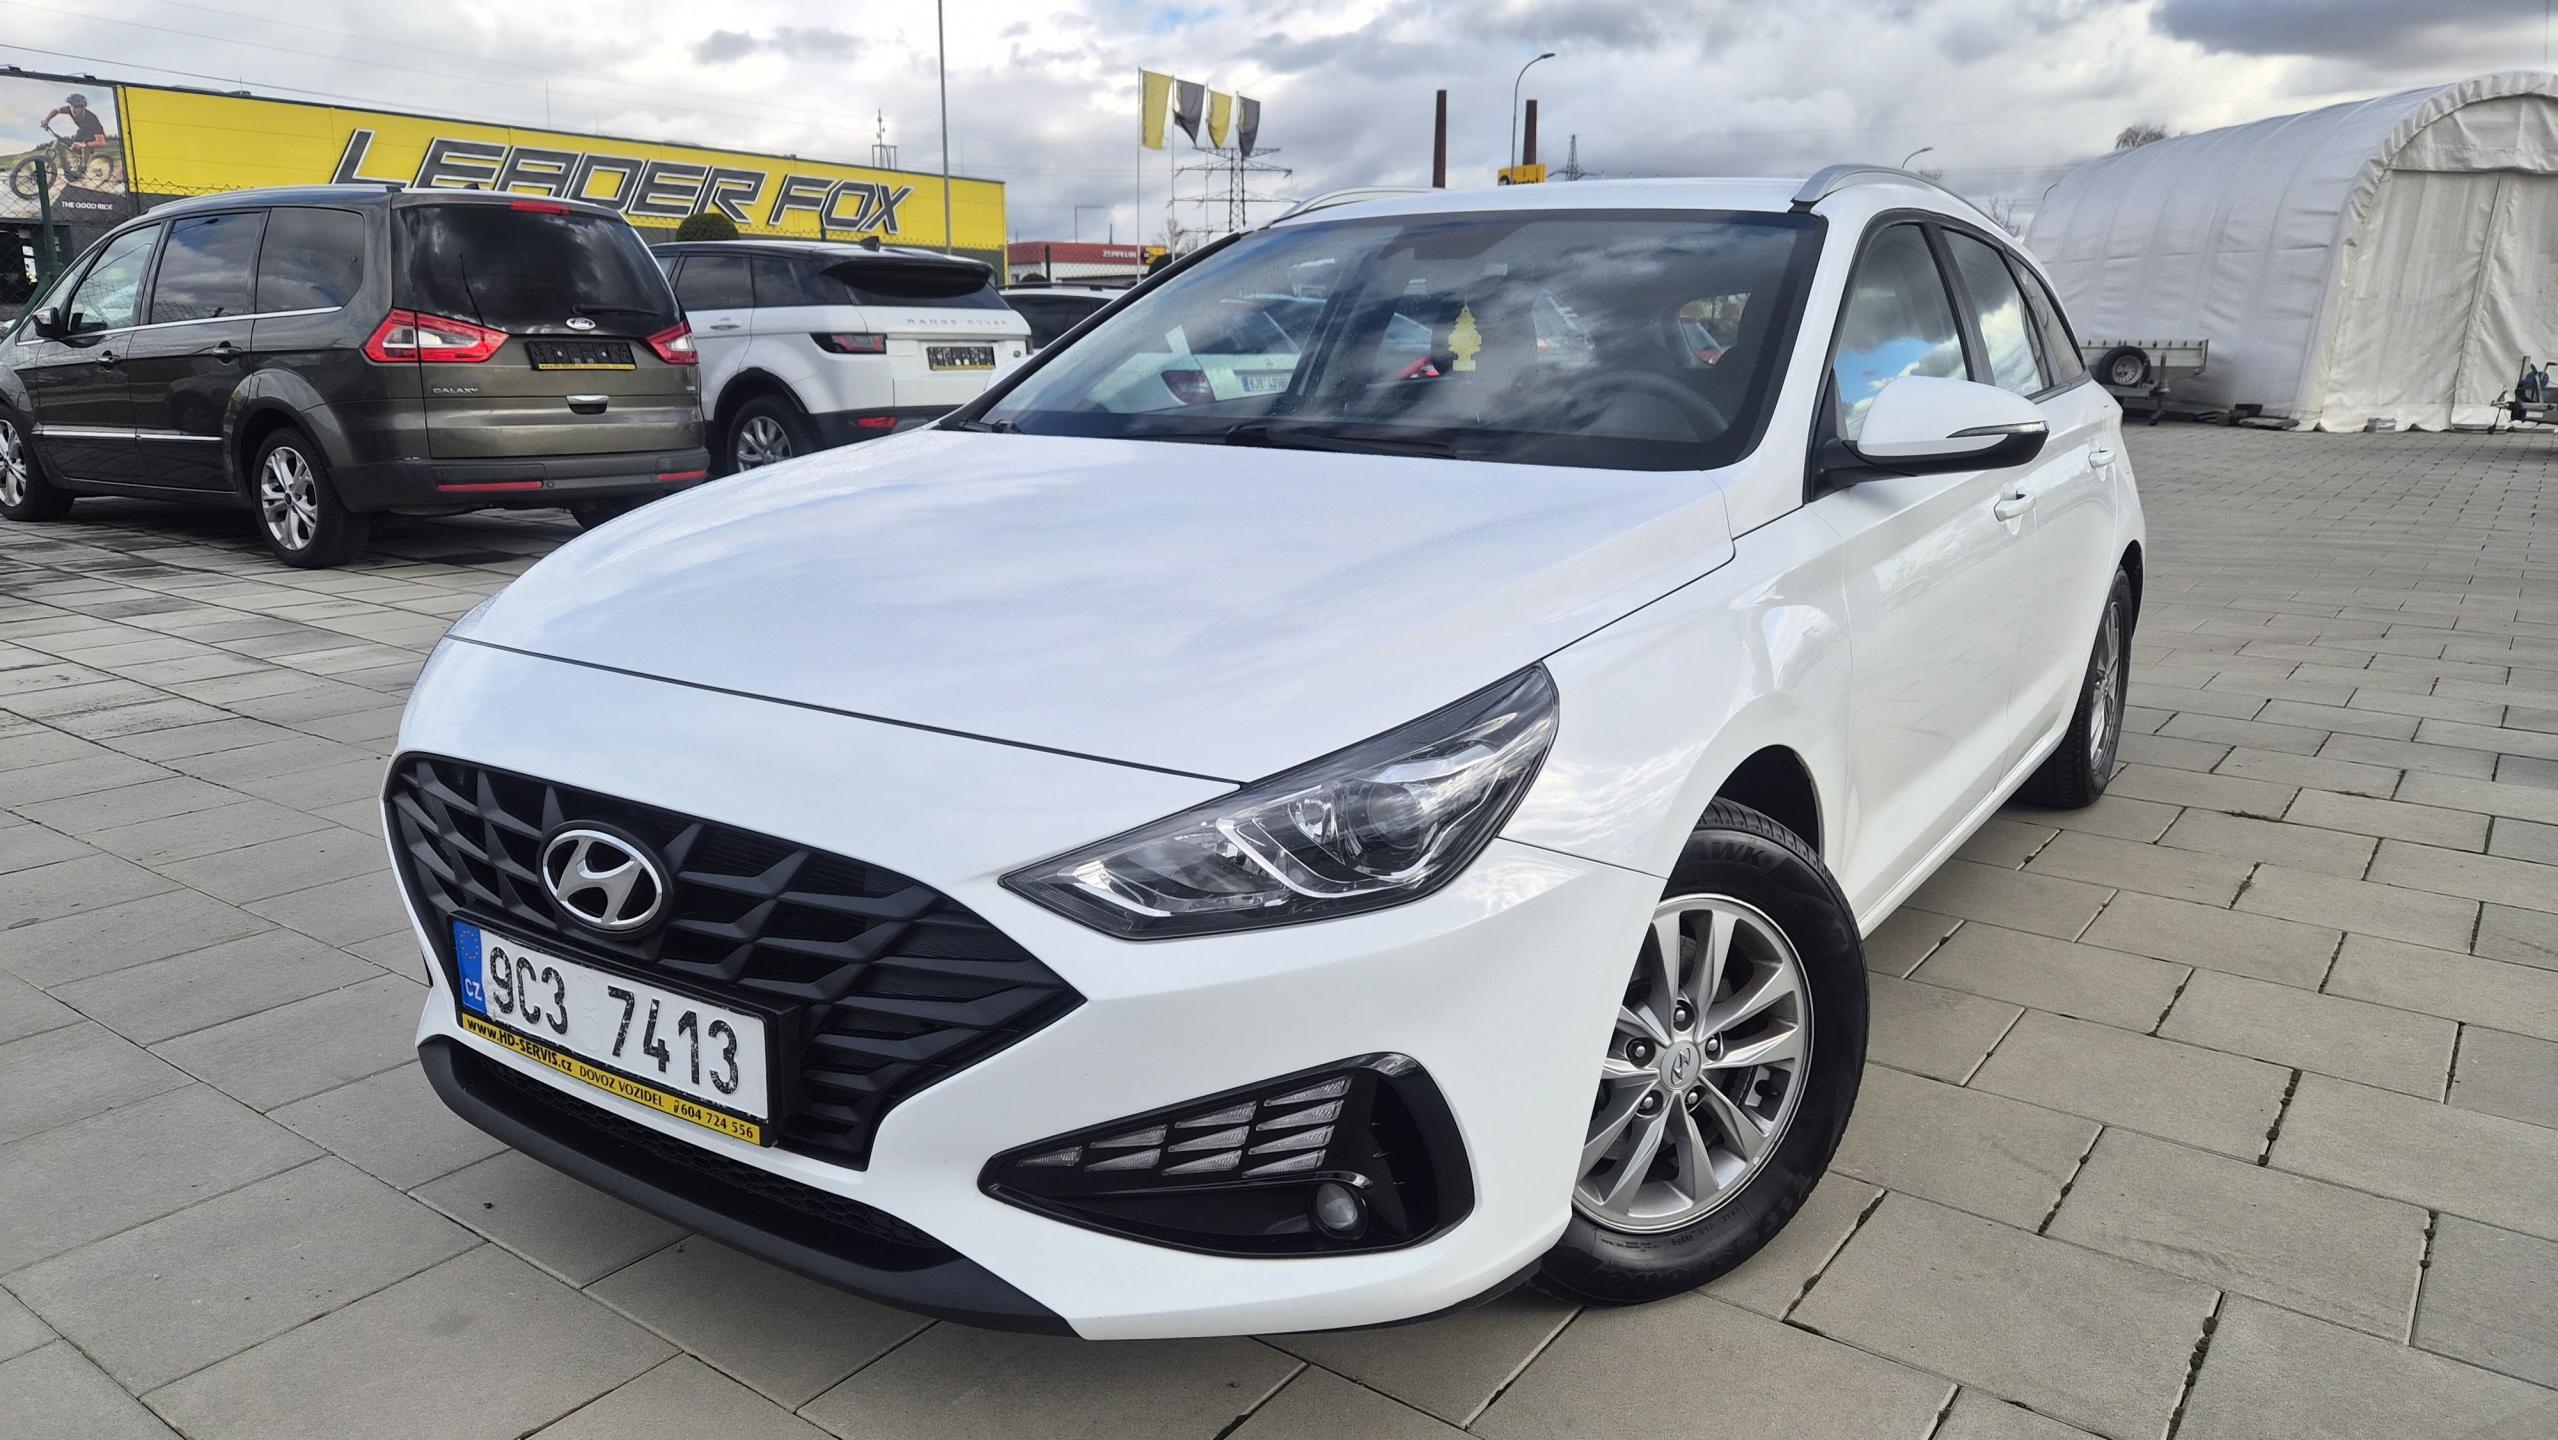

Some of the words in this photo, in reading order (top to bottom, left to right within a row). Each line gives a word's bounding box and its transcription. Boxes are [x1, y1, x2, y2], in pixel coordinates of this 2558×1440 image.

[331, 128, 767, 224] LEADER
[768, 173, 913, 234] FOX
[61, 201, 75, 209] THE
[75, 201, 97, 210] GOOD
[97, 203, 113, 211] RIDE
[906, 317, 958, 326] RANGE
[966, 318, 1008, 327] ROVER
[464, 977, 483, 1001] CZ
[489, 946, 569, 1035] 9C3
[607, 985, 739, 1095] 7413
[579, 1065, 616, 1090] DOVOZ
[618, 1080, 664, 1109] VOZIDEL
[681, 1101, 702, 1121] 604
[706, 1112, 727, 1130] 724
[732, 1121, 753, 1139] 556
